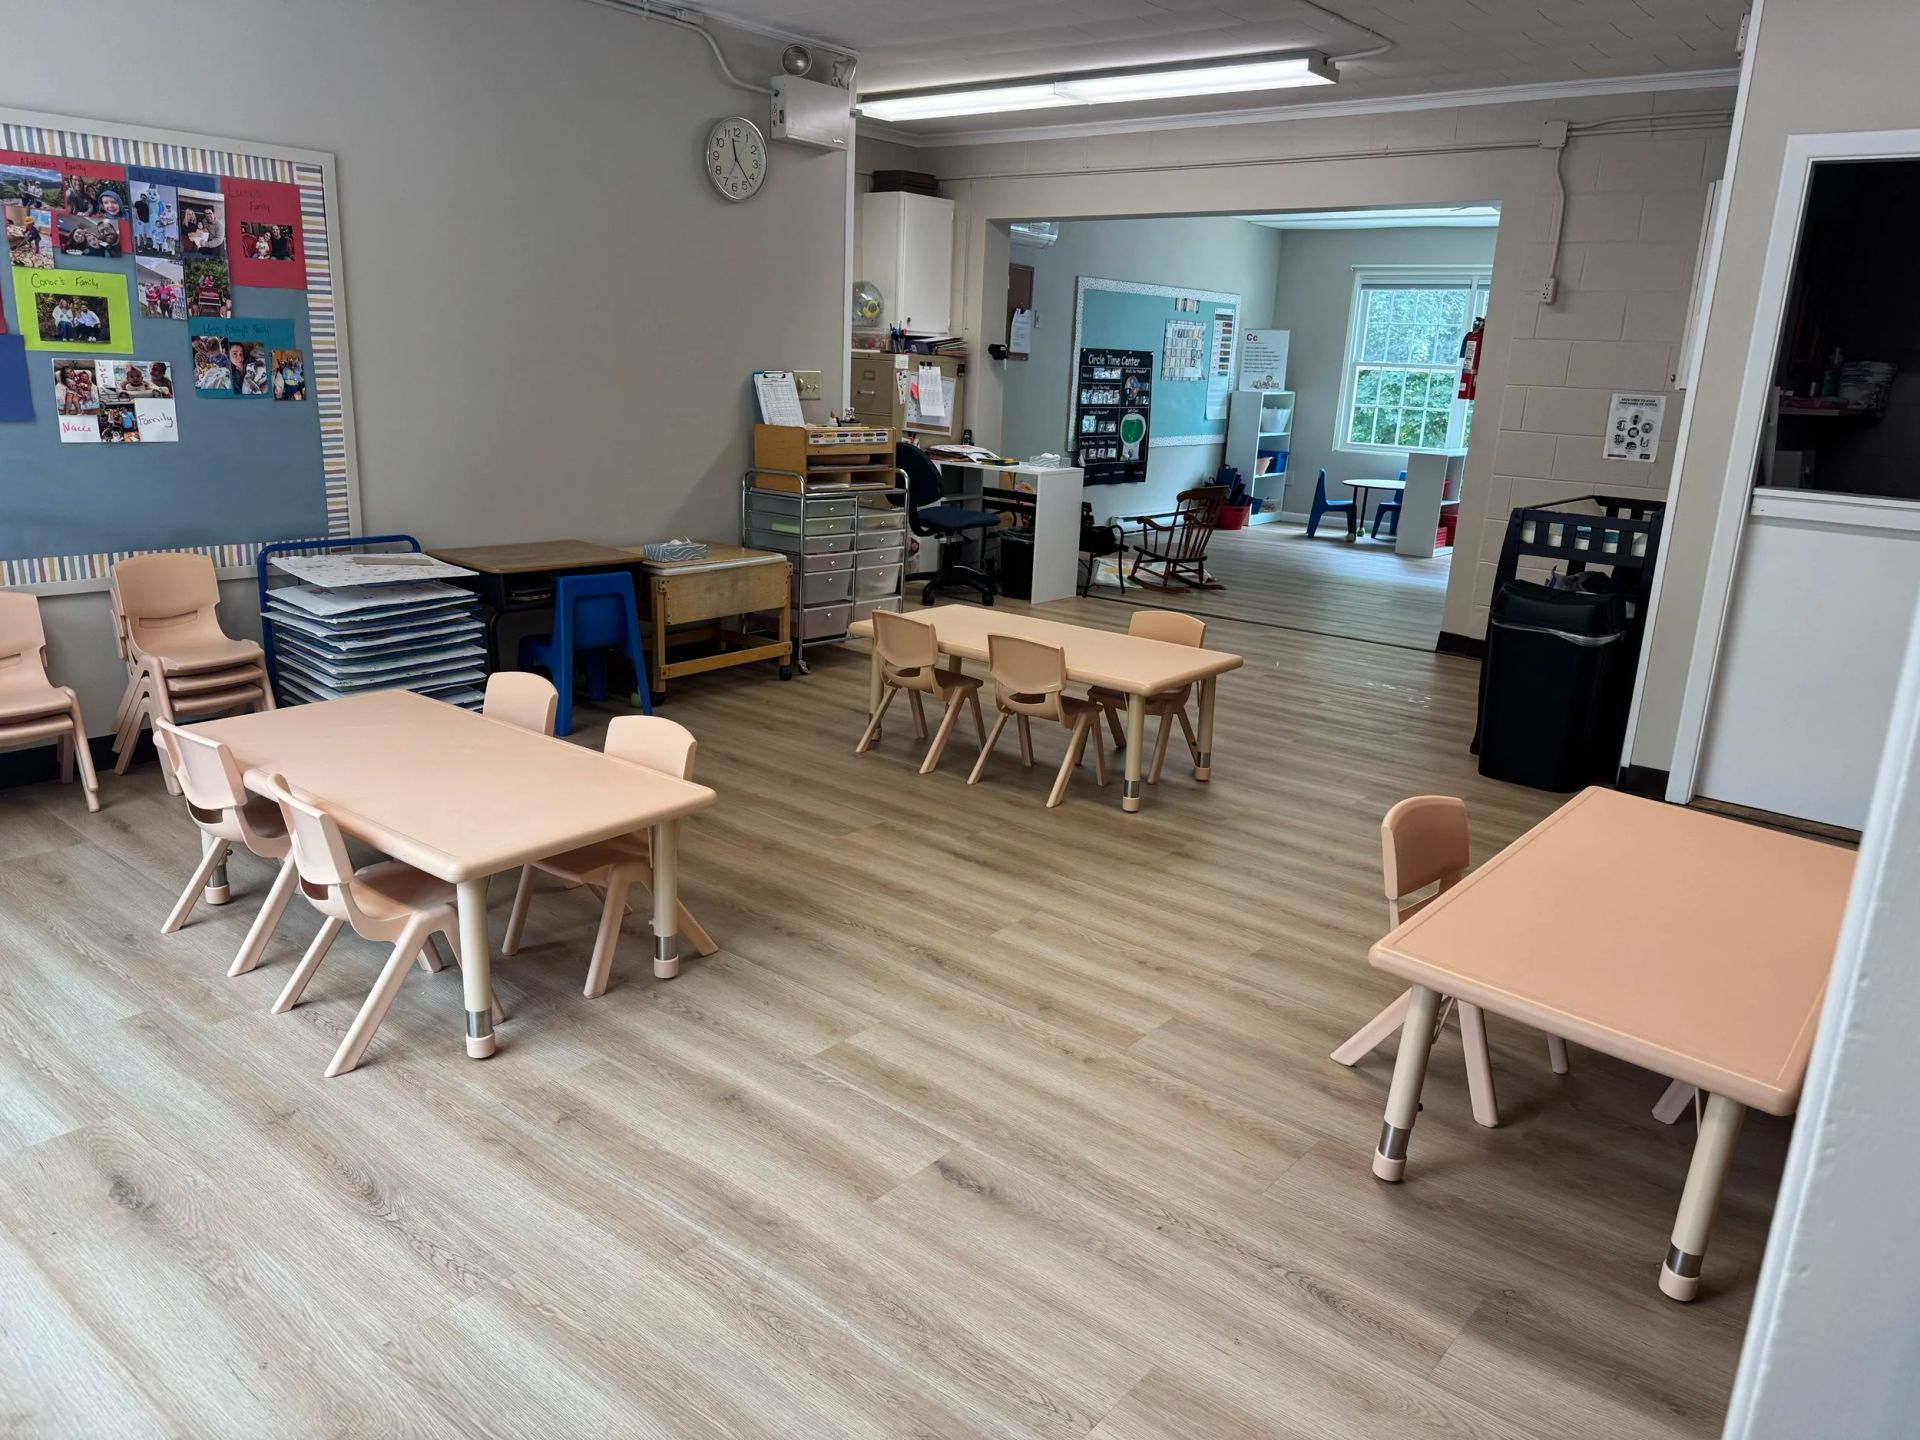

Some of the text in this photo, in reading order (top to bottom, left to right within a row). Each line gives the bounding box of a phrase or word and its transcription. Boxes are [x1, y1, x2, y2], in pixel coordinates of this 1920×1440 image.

[724, 128, 731, 138] 11
[733, 127, 742, 138] 12
[716, 137, 725, 148] 10
[745, 133, 749, 143] 1
[750, 145, 757, 155] 2
[713, 151, 719, 160] 9
[752, 160, 759, 169] 3
[716, 166, 721, 175] 8
[723, 176, 729, 186] 7
[749, 173, 755, 181] 4
[732, 183, 738, 192] 6
[742, 181, 747, 191] 5
[31, 273, 99, 289] Conor's Family
[1246, 333, 1258, 342] Cc
[1088, 354, 1141, 367] Circle Time Center
[138, 413, 174, 429] Family
